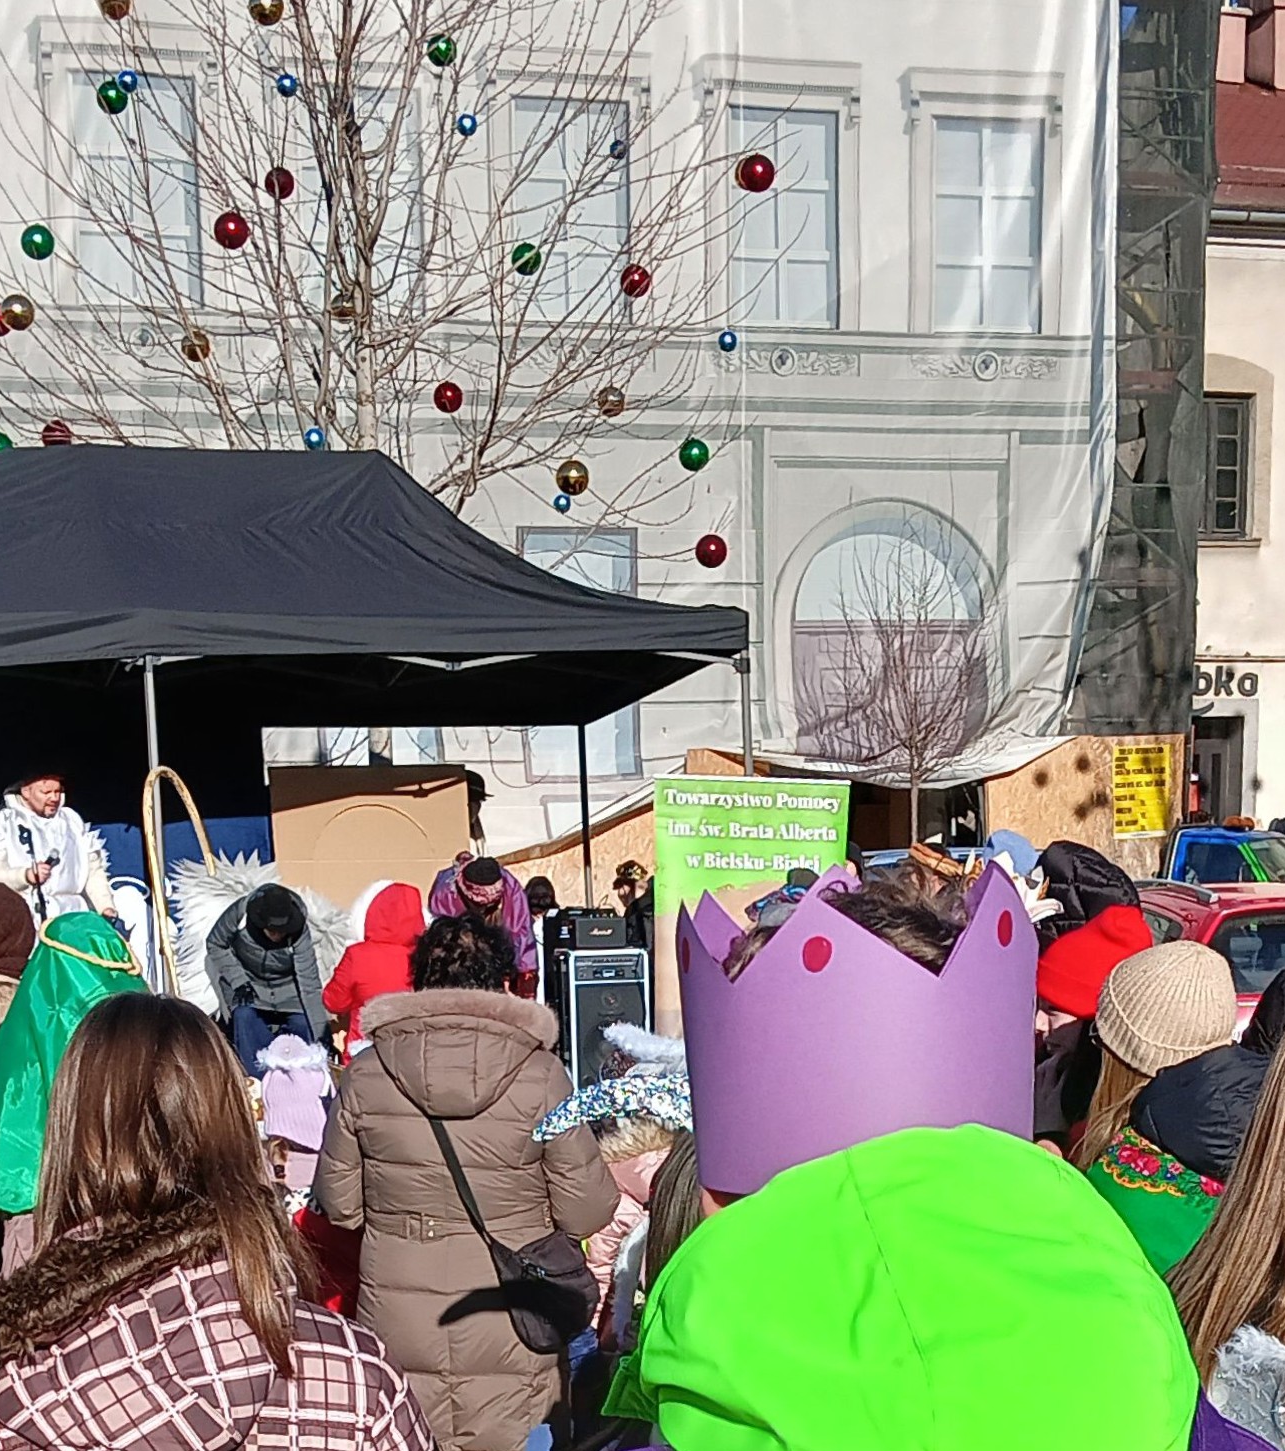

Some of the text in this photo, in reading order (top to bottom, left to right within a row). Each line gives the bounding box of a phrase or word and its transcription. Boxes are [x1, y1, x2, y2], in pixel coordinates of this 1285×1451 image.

[1193, 664, 1258, 697] bka
[664, 788, 841, 813] Towarzystwo Pomocy
[667, 819, 837, 841] im. św. Brata Alberta
[686, 856, 702, 869] w
